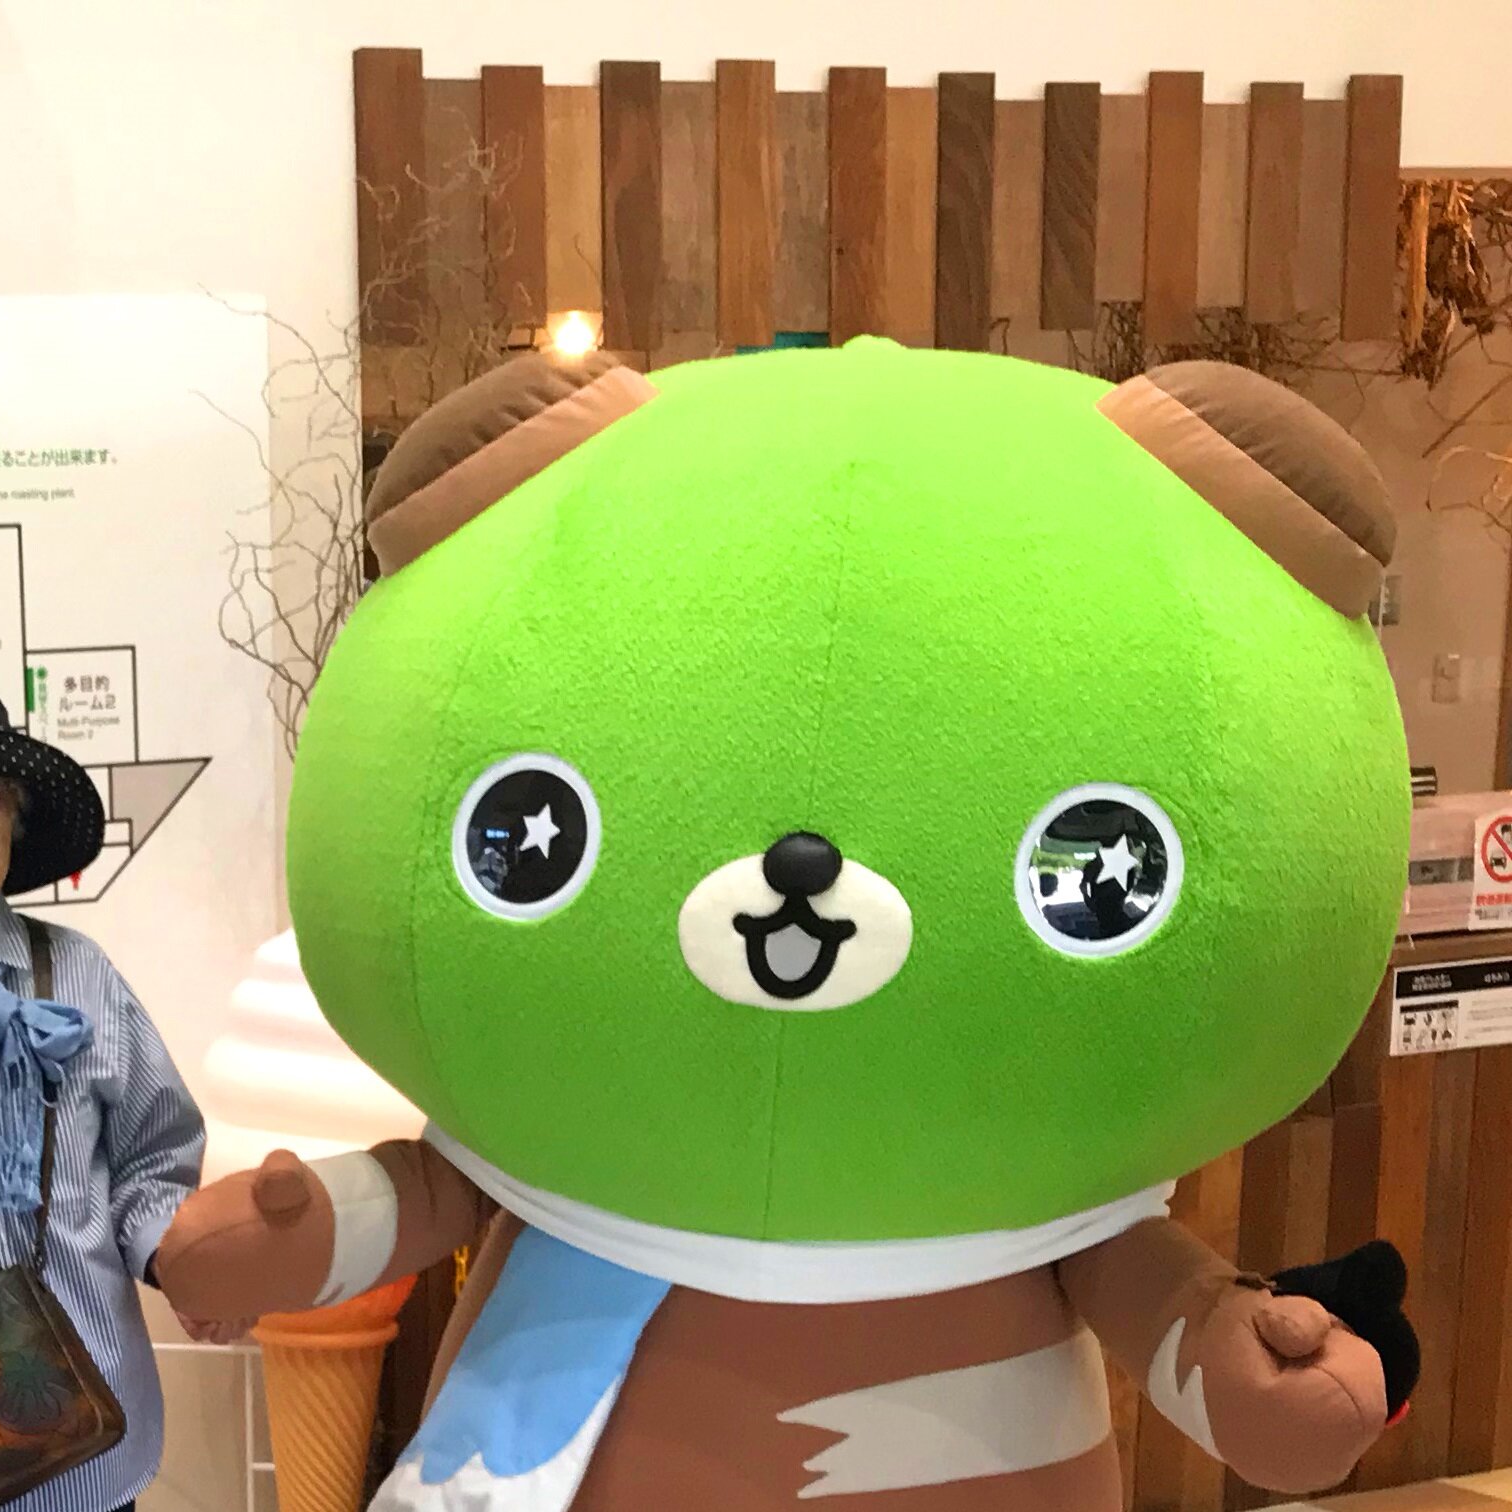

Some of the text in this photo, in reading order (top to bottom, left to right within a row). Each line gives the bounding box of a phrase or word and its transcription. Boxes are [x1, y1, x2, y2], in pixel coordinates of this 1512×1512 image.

[64, 675, 109, 693] 多目的
[59, 693, 116, 713] ルーム2
